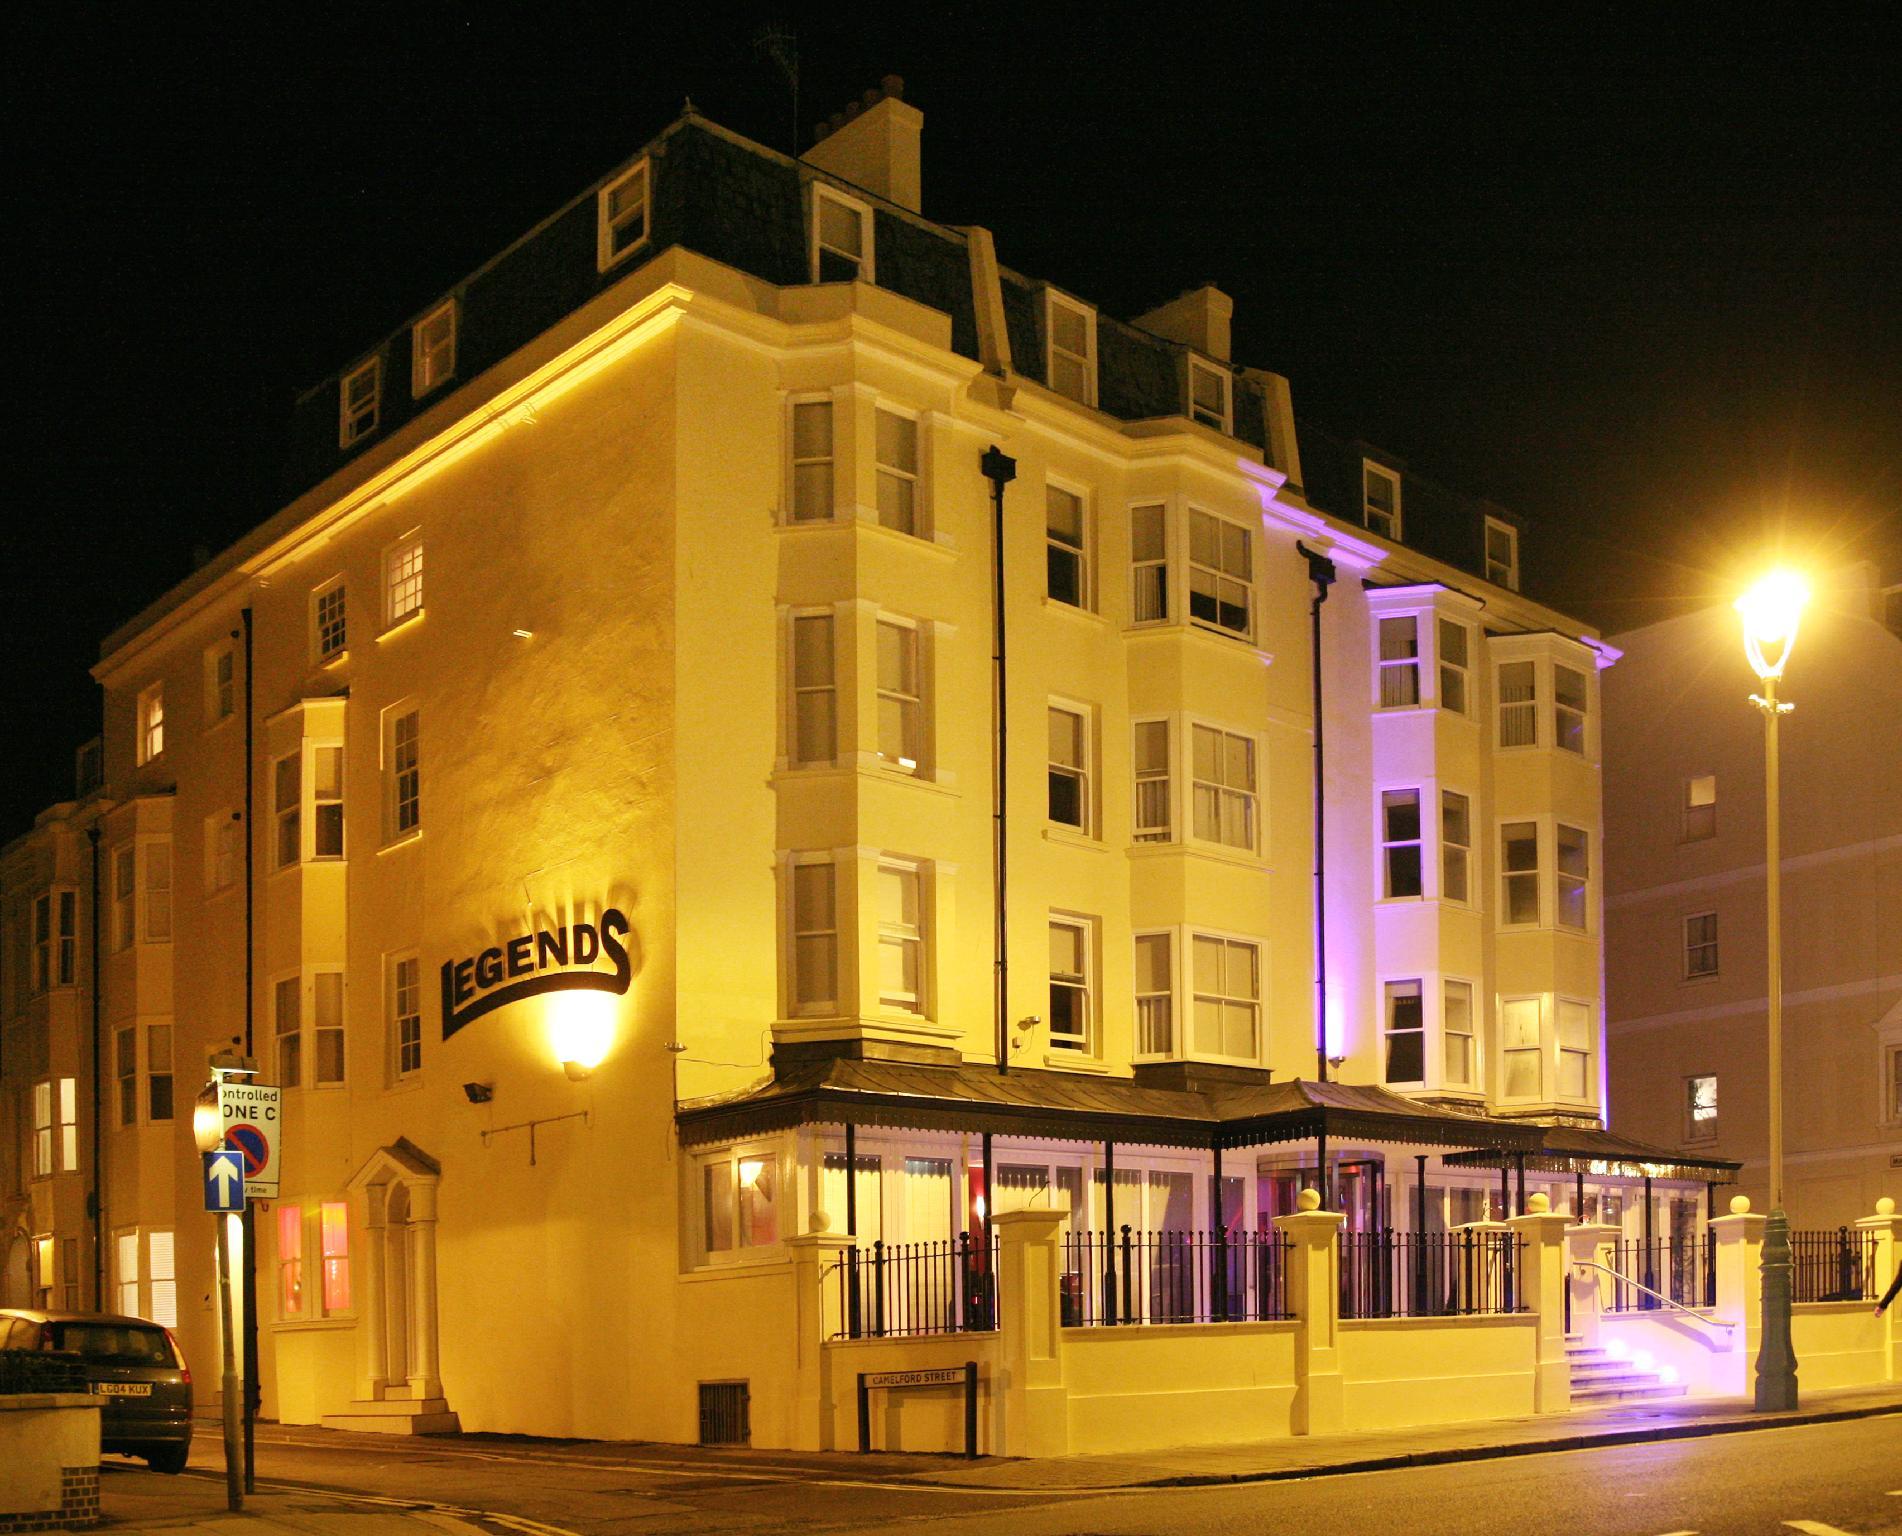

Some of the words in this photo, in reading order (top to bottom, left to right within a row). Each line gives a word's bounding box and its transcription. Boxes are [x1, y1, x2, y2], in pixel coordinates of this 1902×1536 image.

[441, 908, 631, 1042] LEGENDS
[223, 1088, 277, 1102] ontrolled
[223, 1104, 258, 1119] ONE
[265, 1106, 276, 1121] C
[873, 1374, 922, 1385] CAMELFORD
[924, 1371, 956, 1382] STREET
[128, 1384, 149, 1394] KUX
